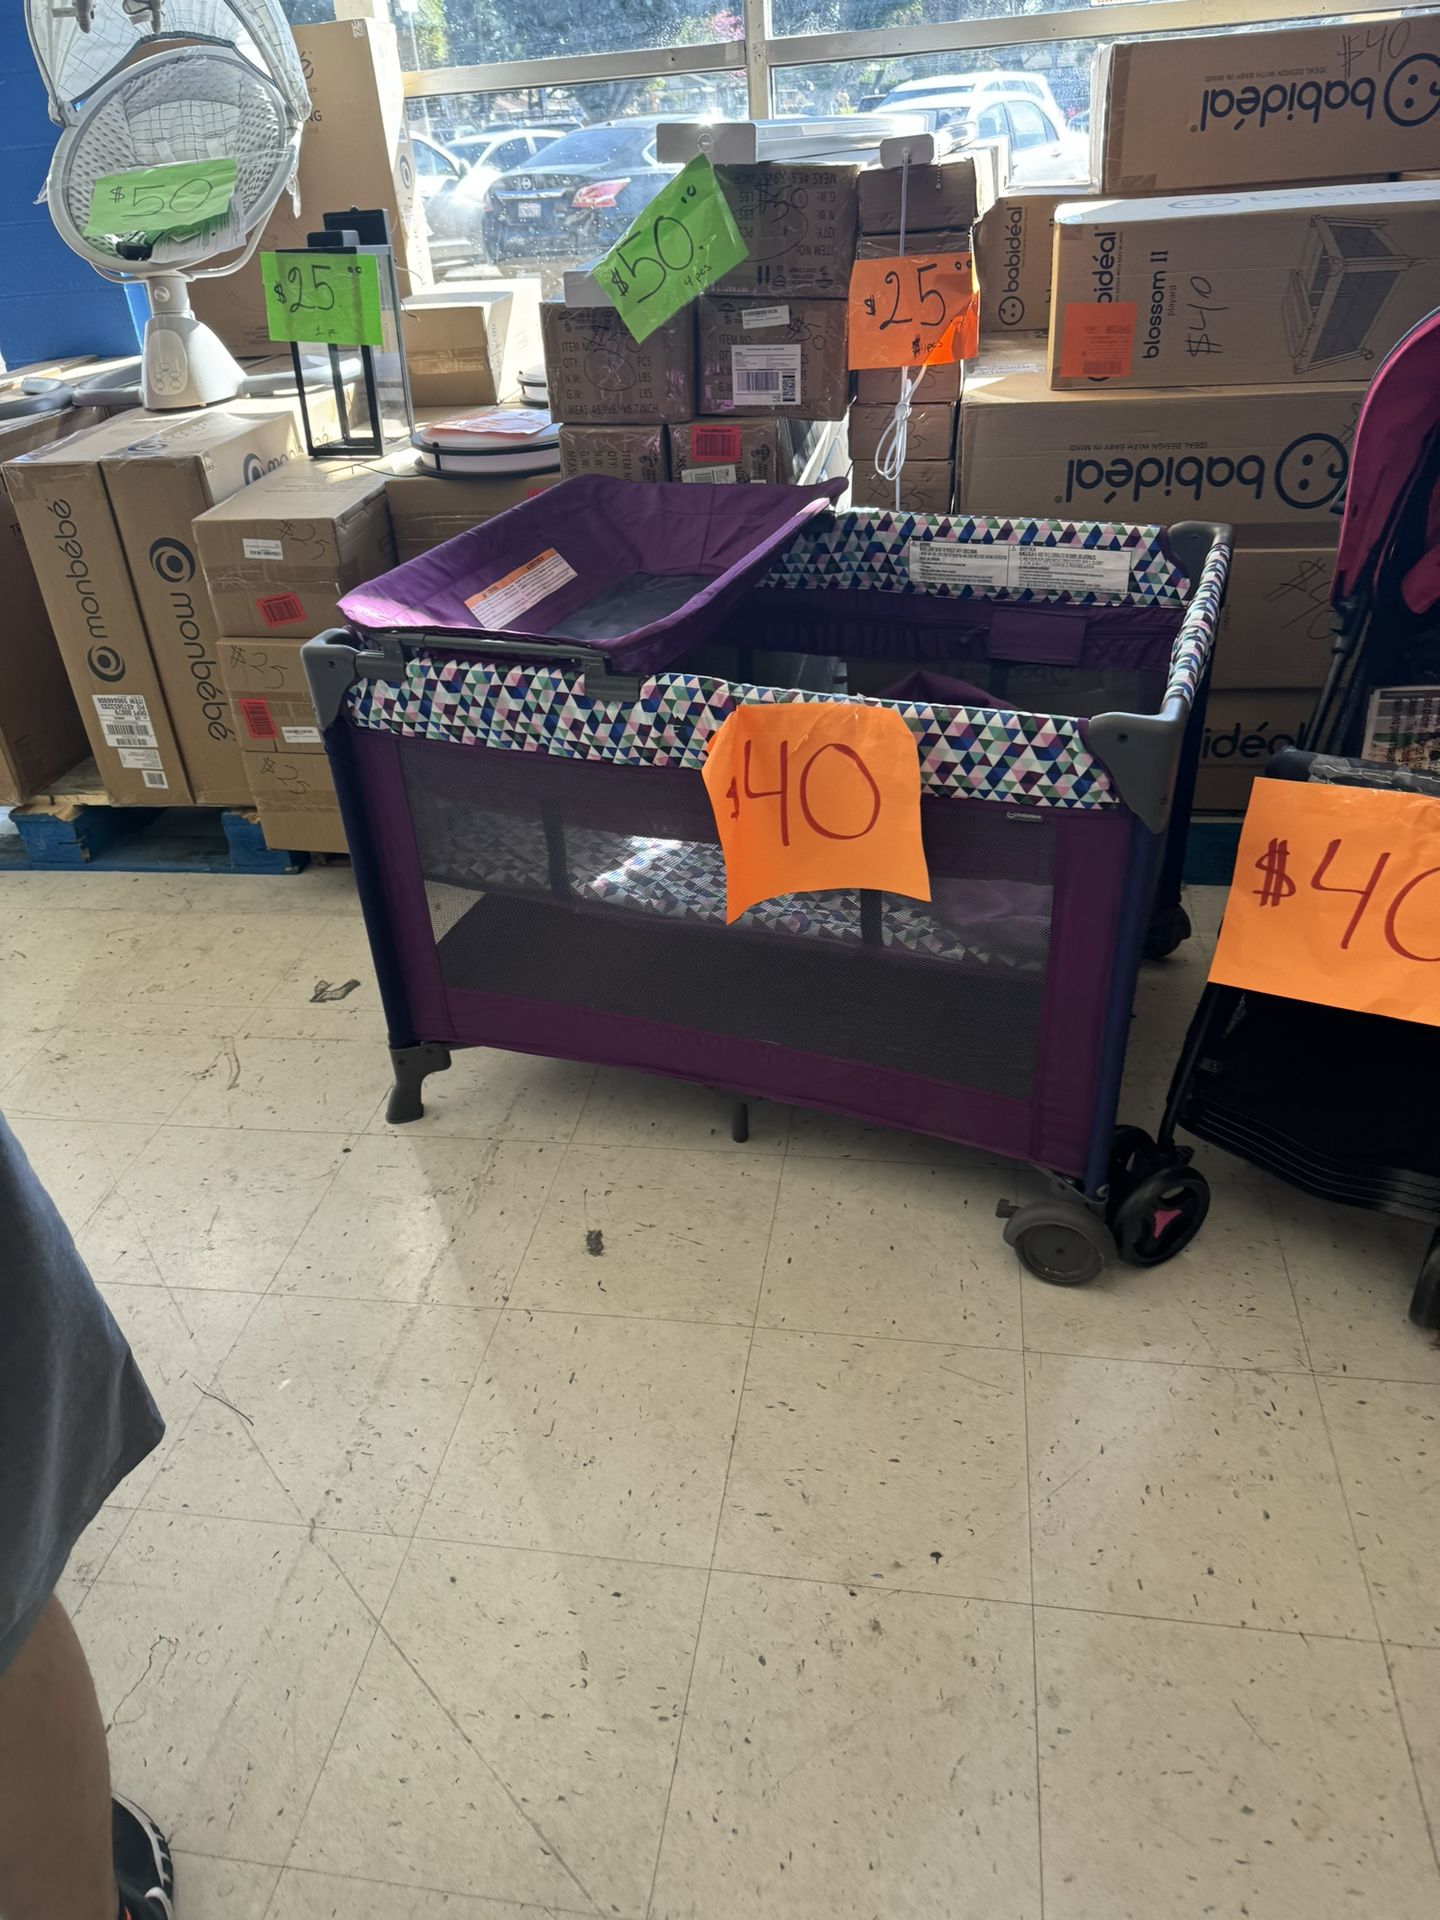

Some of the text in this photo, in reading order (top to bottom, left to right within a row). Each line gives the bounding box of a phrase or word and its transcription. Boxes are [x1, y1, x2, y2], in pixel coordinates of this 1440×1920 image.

[1337, 21, 1411, 79] $40
[109, 177, 214, 219] $50
[1142, 270, 1167, 359] blossom
[1167, 285, 1177, 317] playard
[1186, 275, 1228, 358] $40
[636, 356, 653, 367] PCS
[638, 372, 653, 383] LBS
[639, 388, 654, 399] LBS
[1068, 443, 1092, 452] MIND
[1093, 443, 1103, 451] IN
[1127, 442, 1151, 451] WITH
[47, 498, 108, 639] monbébé
[170, 591, 235, 742] monbébé
[725, 739, 882, 847] $40
